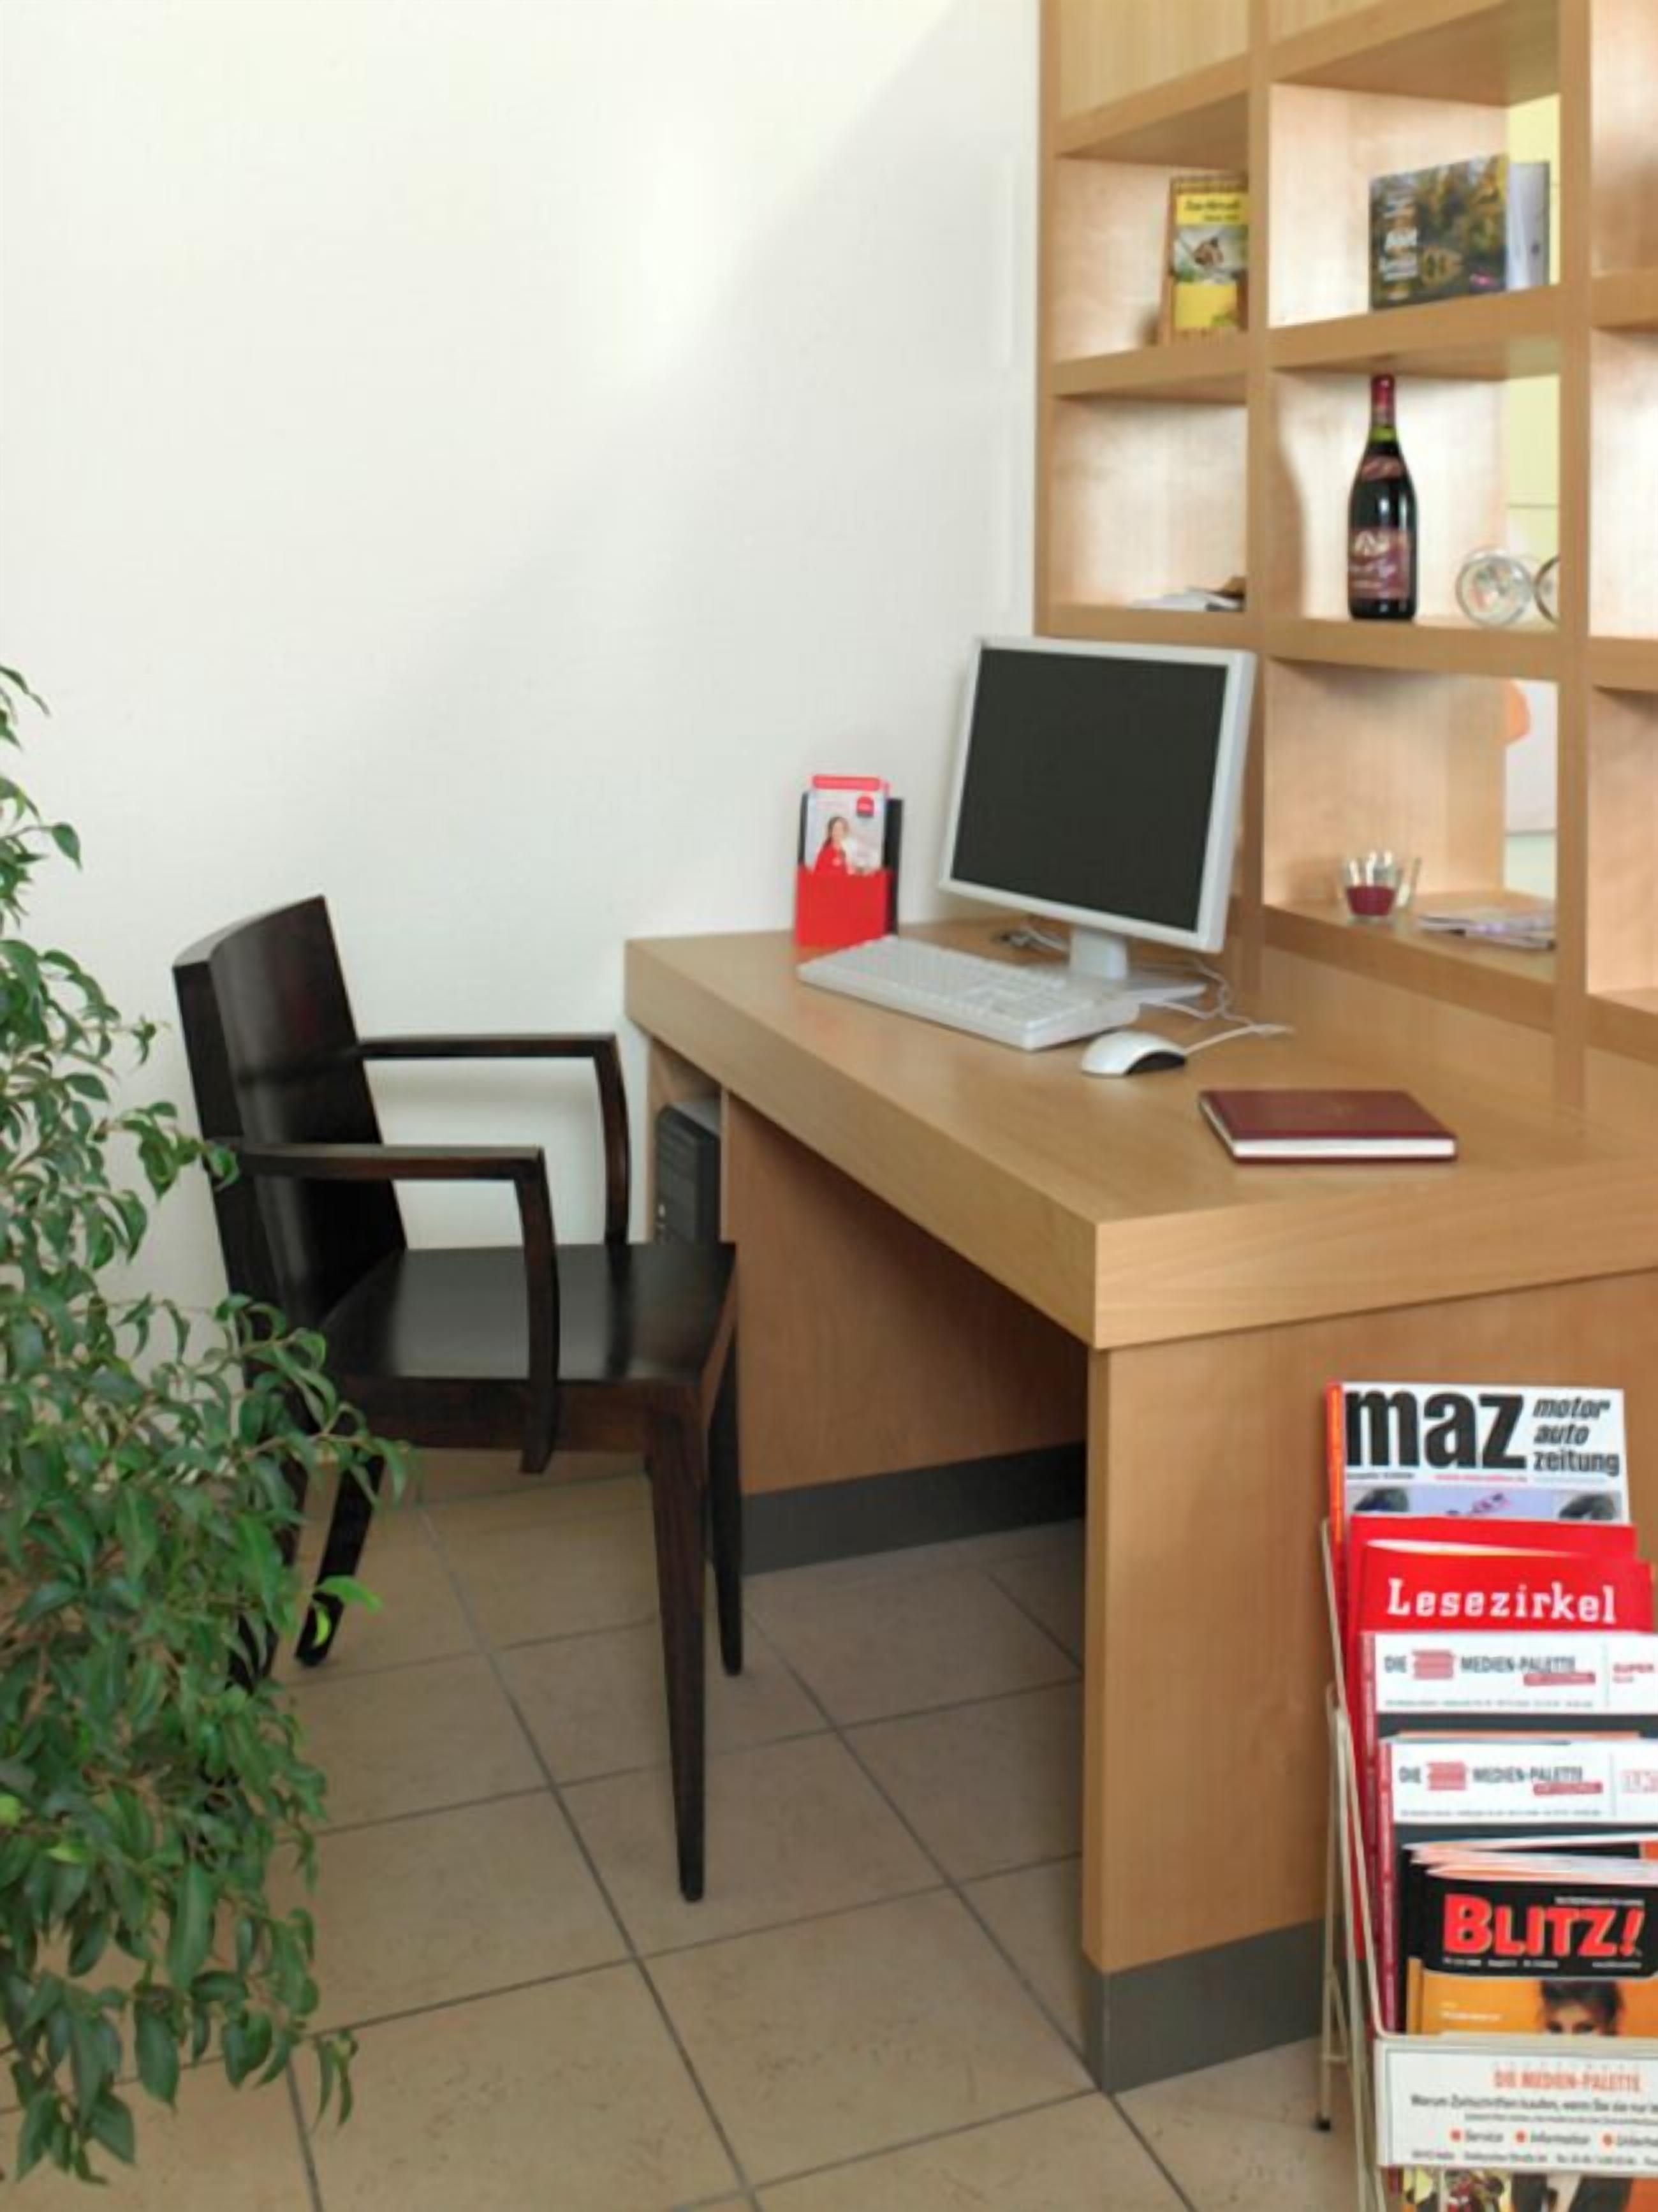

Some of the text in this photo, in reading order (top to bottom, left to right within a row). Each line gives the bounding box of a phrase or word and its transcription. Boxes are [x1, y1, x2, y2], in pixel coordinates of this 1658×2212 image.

[1532, 1397, 1611, 1419] motor
[1346, 1391, 1526, 1469] maz
[1534, 1423, 1590, 1445] auto
[1533, 1450, 1620, 1477] zeitung
[1387, 1577, 1617, 1625] Lesezirkel
[1384, 1655, 1407, 1673] DIE
